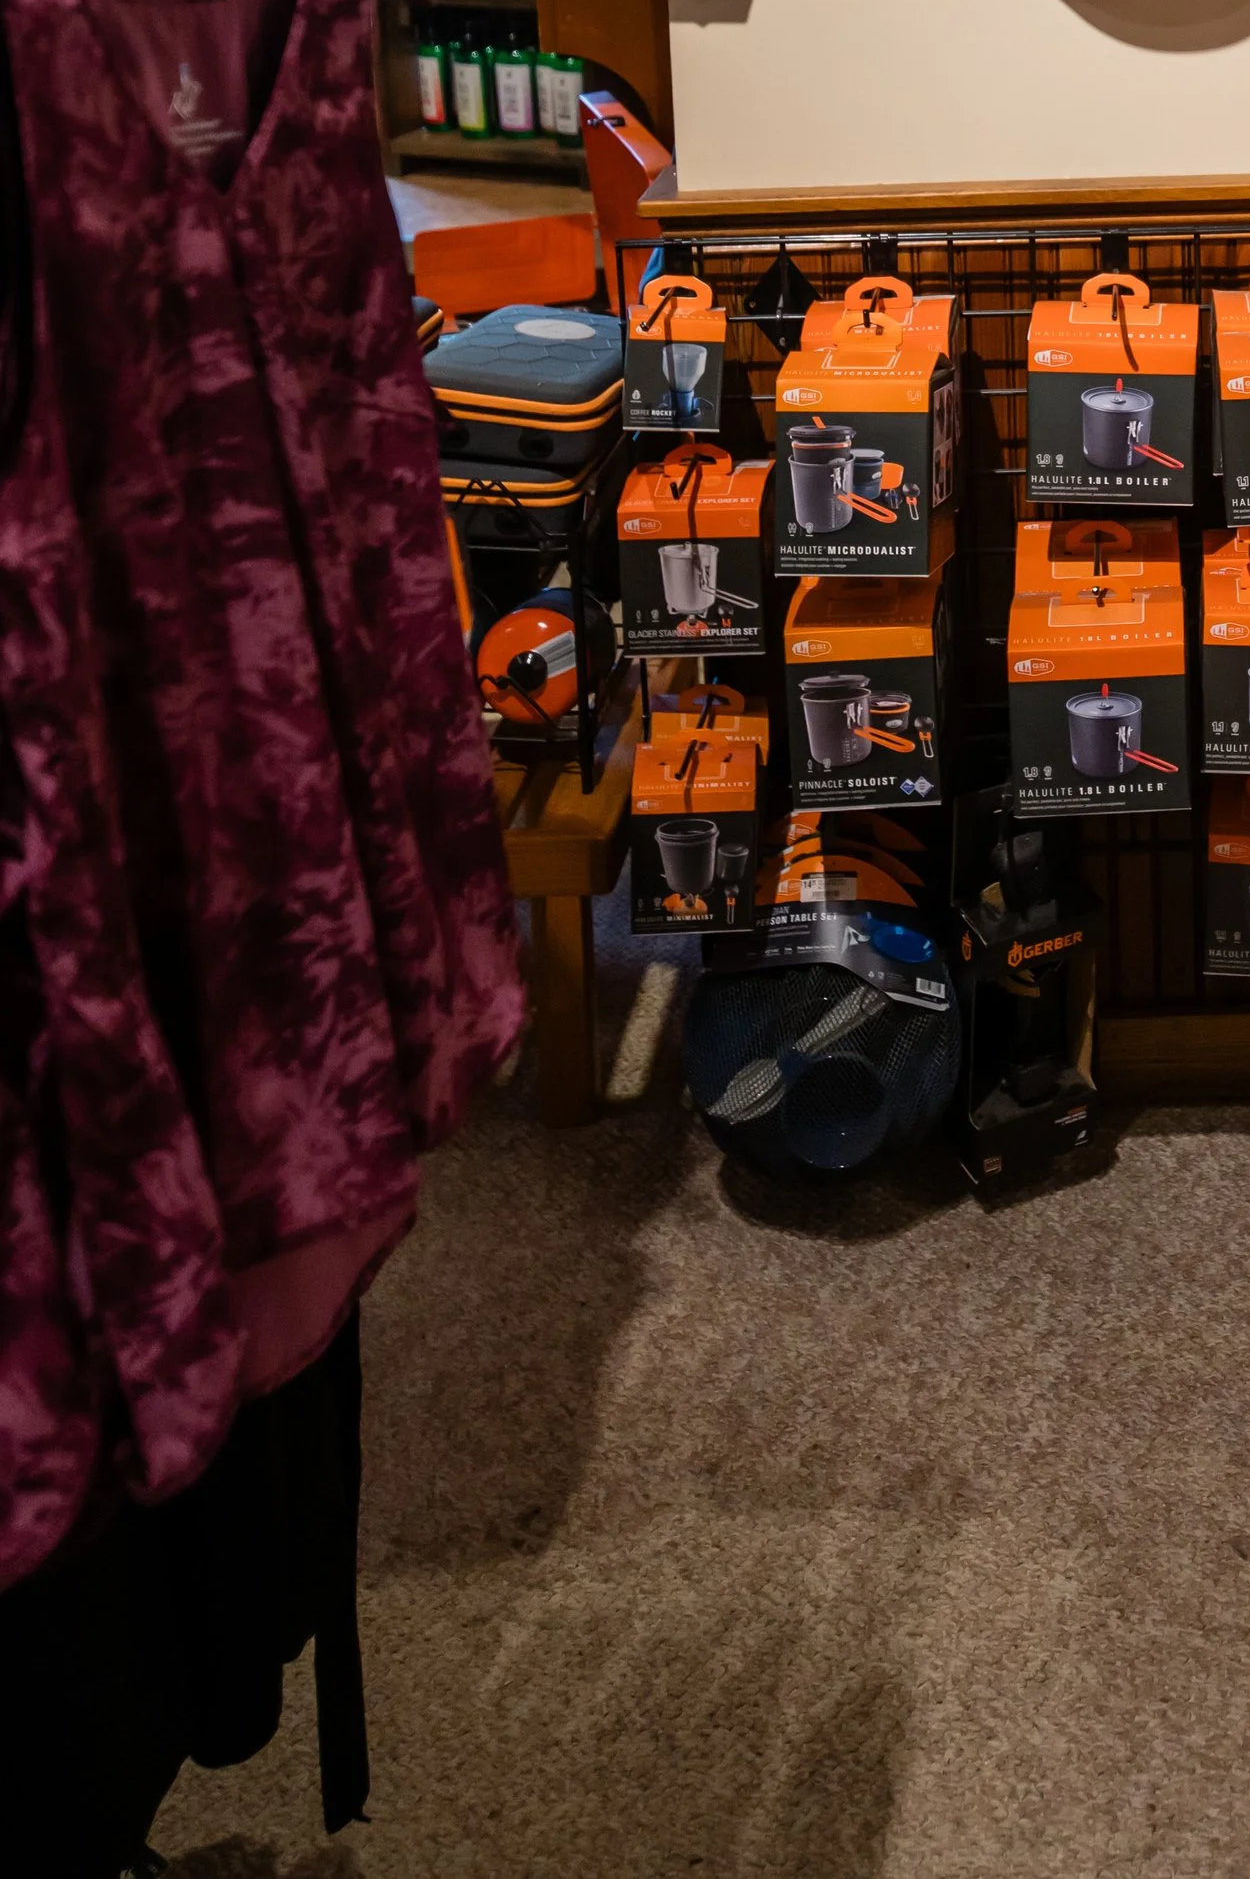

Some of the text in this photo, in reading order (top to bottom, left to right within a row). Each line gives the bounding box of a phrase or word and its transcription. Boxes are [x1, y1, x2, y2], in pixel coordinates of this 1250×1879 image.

[1051, 354, 1068, 362] GSI
[651, 409, 677, 417] ROCKET
[1031, 475, 1083, 485] HALULITE
[1116, 477, 1170, 486] BOILER
[779, 545, 915, 556] HALULITE MICRODUALIST
[627, 629, 658, 639] GLACIER
[700, 627, 741, 637] EXPLORER
[743, 627, 758, 635] SET
[1110, 631, 1173, 641] BOILER
[1032, 662, 1050, 670] GSI
[799, 777, 897, 790] PINNACLE SOLOIST
[1019, 787, 1074, 798] HALULITE
[1108, 782, 1165, 794] BOILER
[666, 913, 714, 922] MINIMALIST
[790, 912, 838, 923] TABLE SET
[1023, 931, 1083, 959] GERBER
